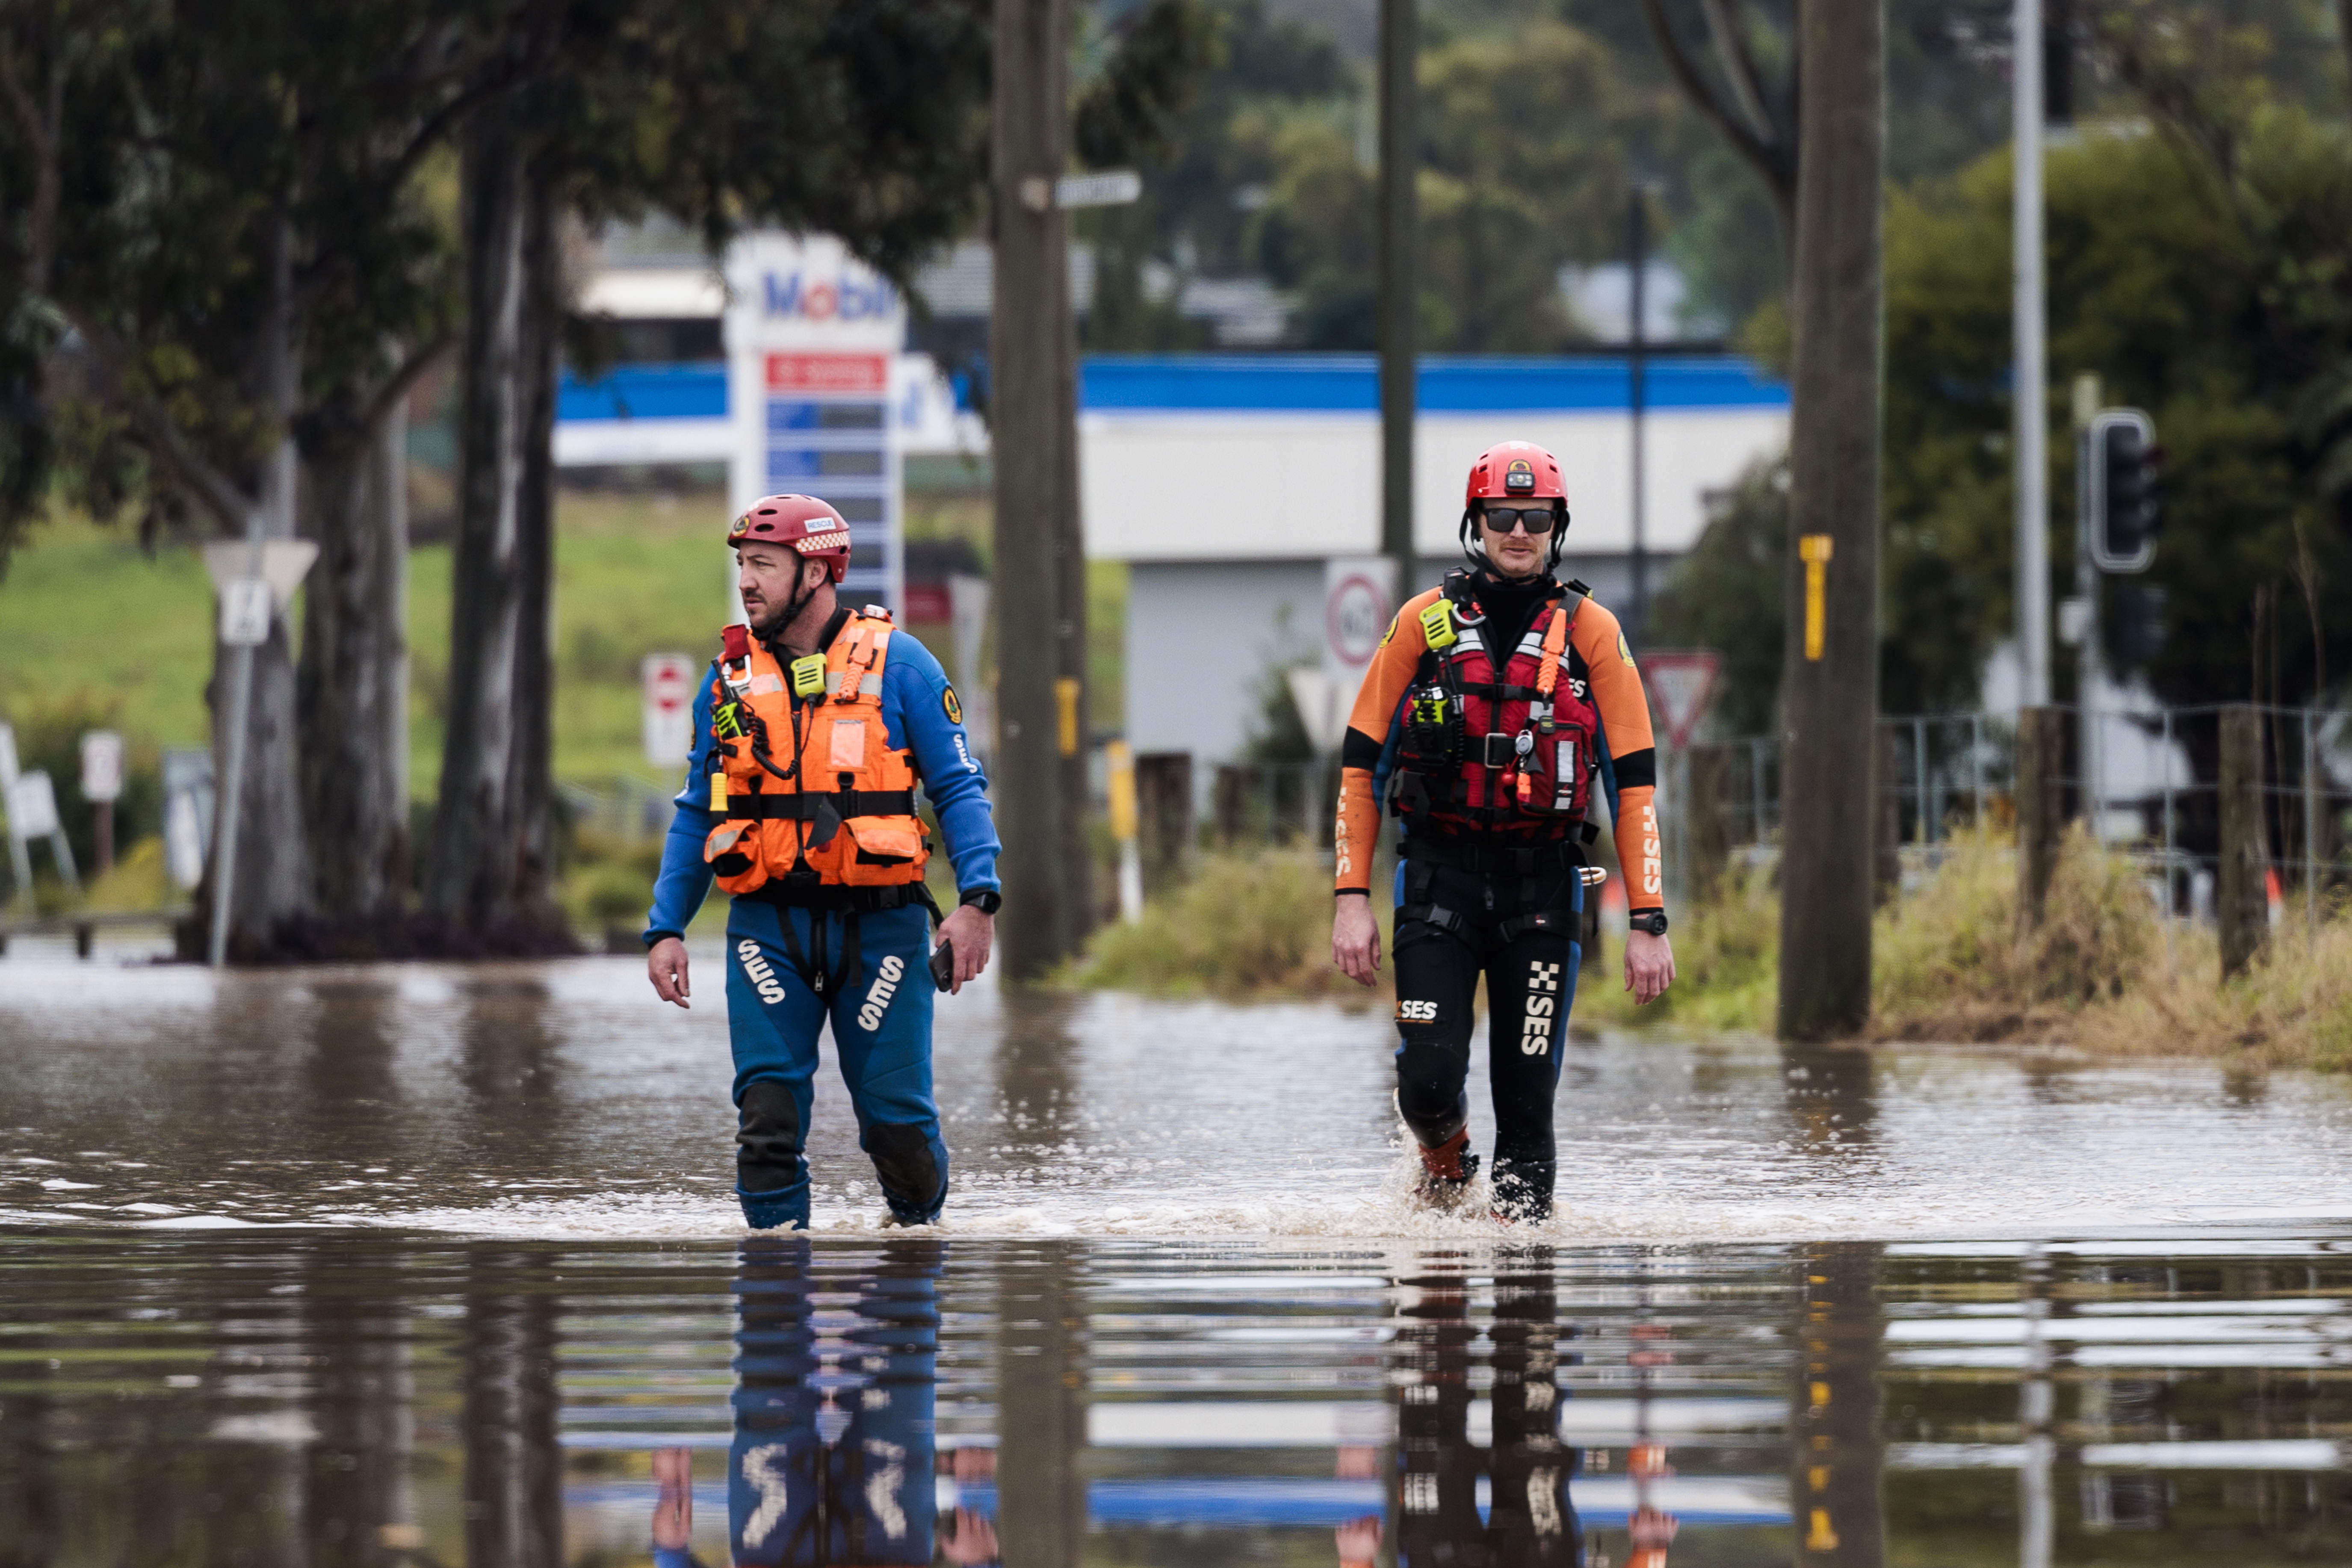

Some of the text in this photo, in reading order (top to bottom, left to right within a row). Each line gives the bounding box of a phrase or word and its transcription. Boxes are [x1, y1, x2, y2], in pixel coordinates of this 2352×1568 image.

[808, 520, 834, 529] RESCUE
[954, 733, 978, 774] SES
[1643, 839, 1662, 894] SES
[738, 939, 785, 1004] SES
[858, 955, 904, 1031] SES
[1402, 1000, 1438, 1020] SES
[1521, 995, 1554, 1055] SES
